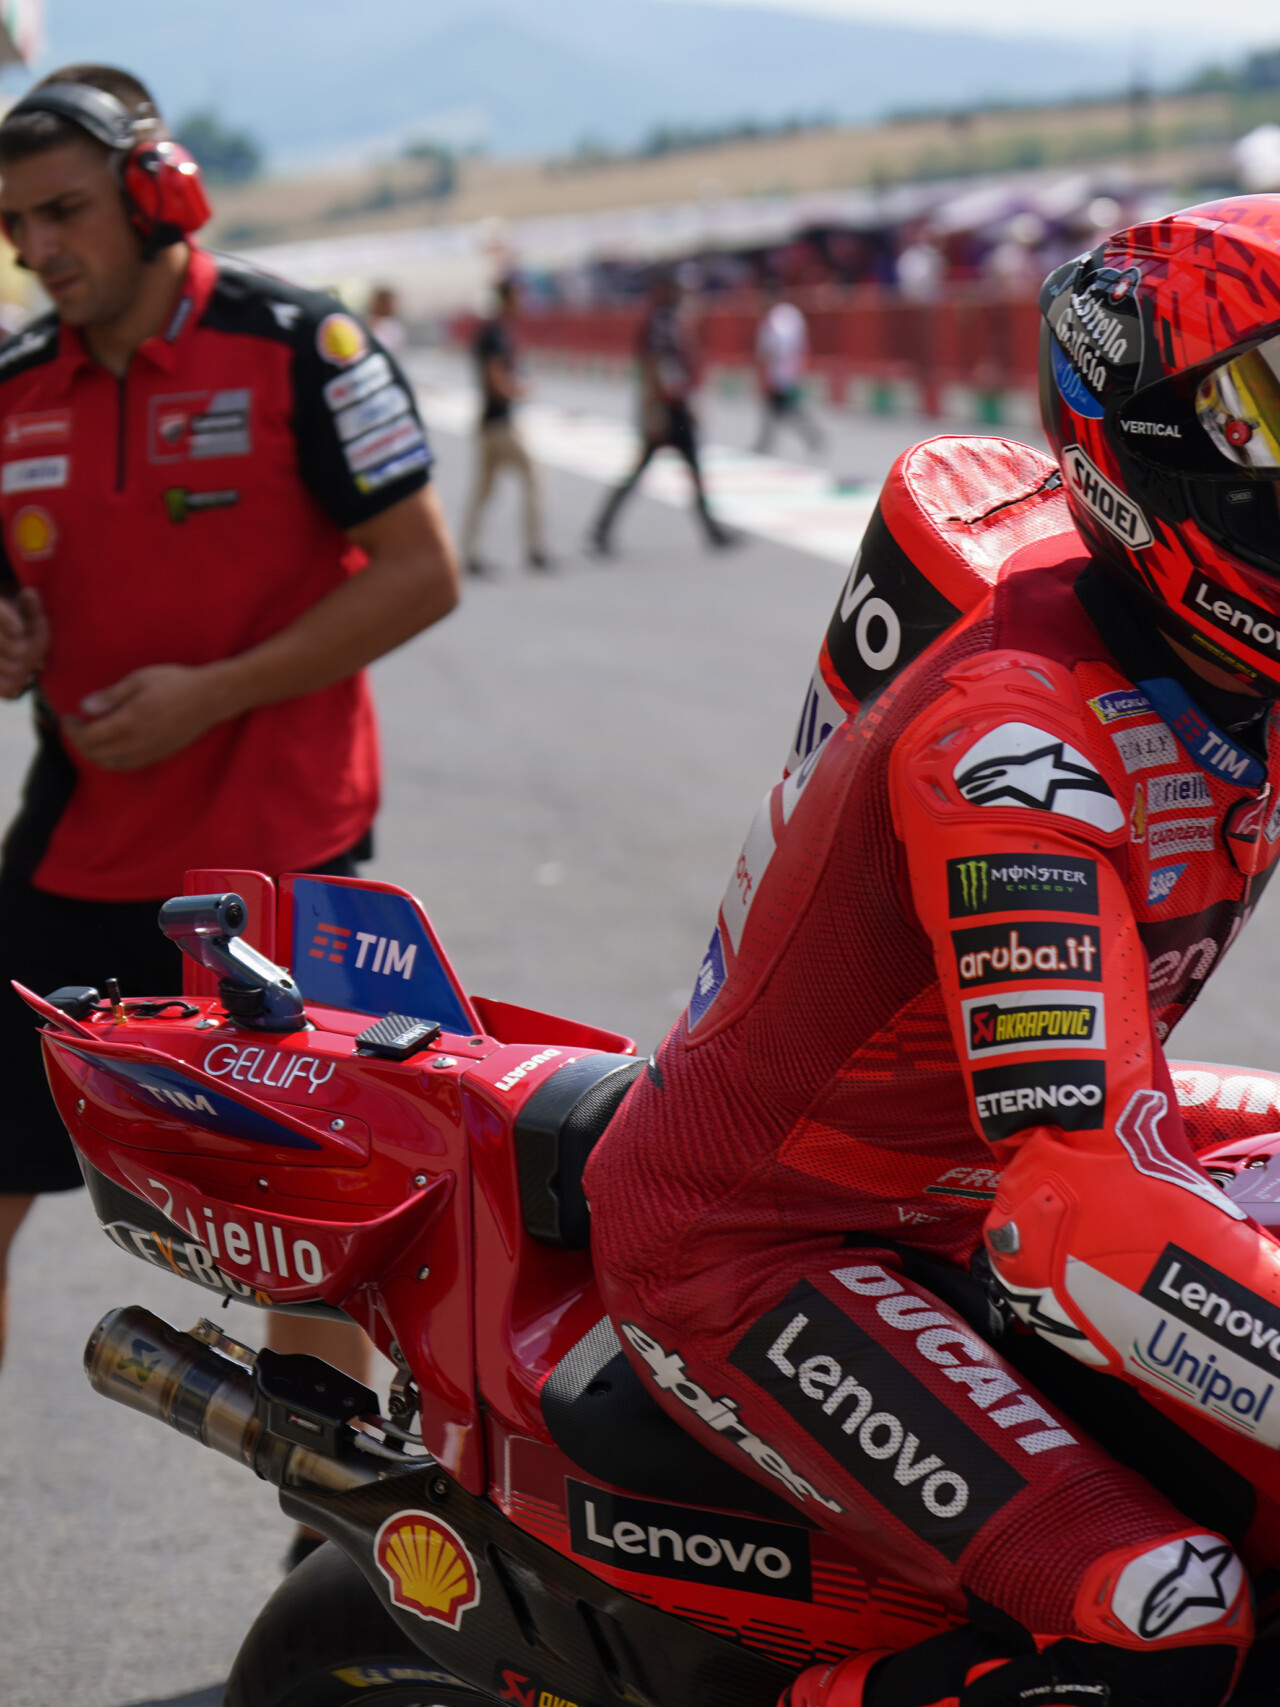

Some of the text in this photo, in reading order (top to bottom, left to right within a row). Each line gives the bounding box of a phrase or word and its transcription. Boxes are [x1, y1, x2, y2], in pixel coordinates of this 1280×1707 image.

[1070, 284, 1128, 364] Estrella
[1056, 308, 1107, 391] Galicia
[1120, 420, 1182, 438] VERTICAL
[1070, 455, 1138, 541] SHOEI
[1200, 731, 1250, 780] TIM
[991, 862, 1087, 886] MONSTER
[1006, 884, 1075, 894] ENERGY
[354, 931, 418, 980] TIM
[959, 931, 1097, 979] aruba.it
[996, 1008, 1091, 1041] AKRAPOVIČ
[203, 1043, 336, 1095] GELLIFY
[495, 1048, 563, 1092] DUCATI
[139, 1083, 218, 1116] TIM
[828, 1264, 1080, 1457] DUCATI
[1147, 1319, 1275, 1424] Unipol
[766, 1312, 970, 1519] Lenovo
[584, 1500, 792, 1579] Lenovo
